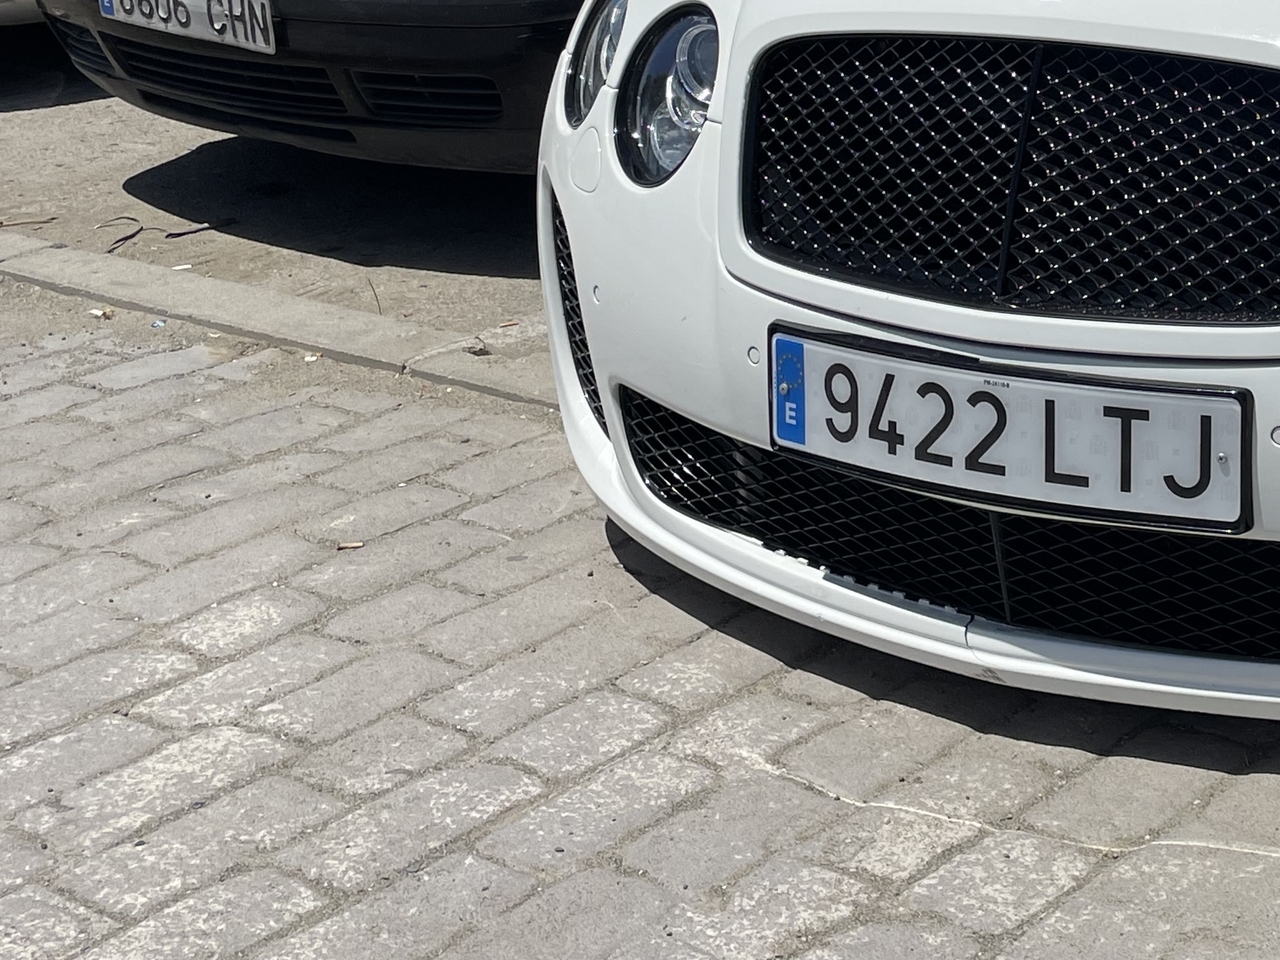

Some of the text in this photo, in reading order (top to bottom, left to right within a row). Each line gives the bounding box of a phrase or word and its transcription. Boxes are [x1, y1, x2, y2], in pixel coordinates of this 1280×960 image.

[785, 362, 1212, 499] E 9422 LTJ
